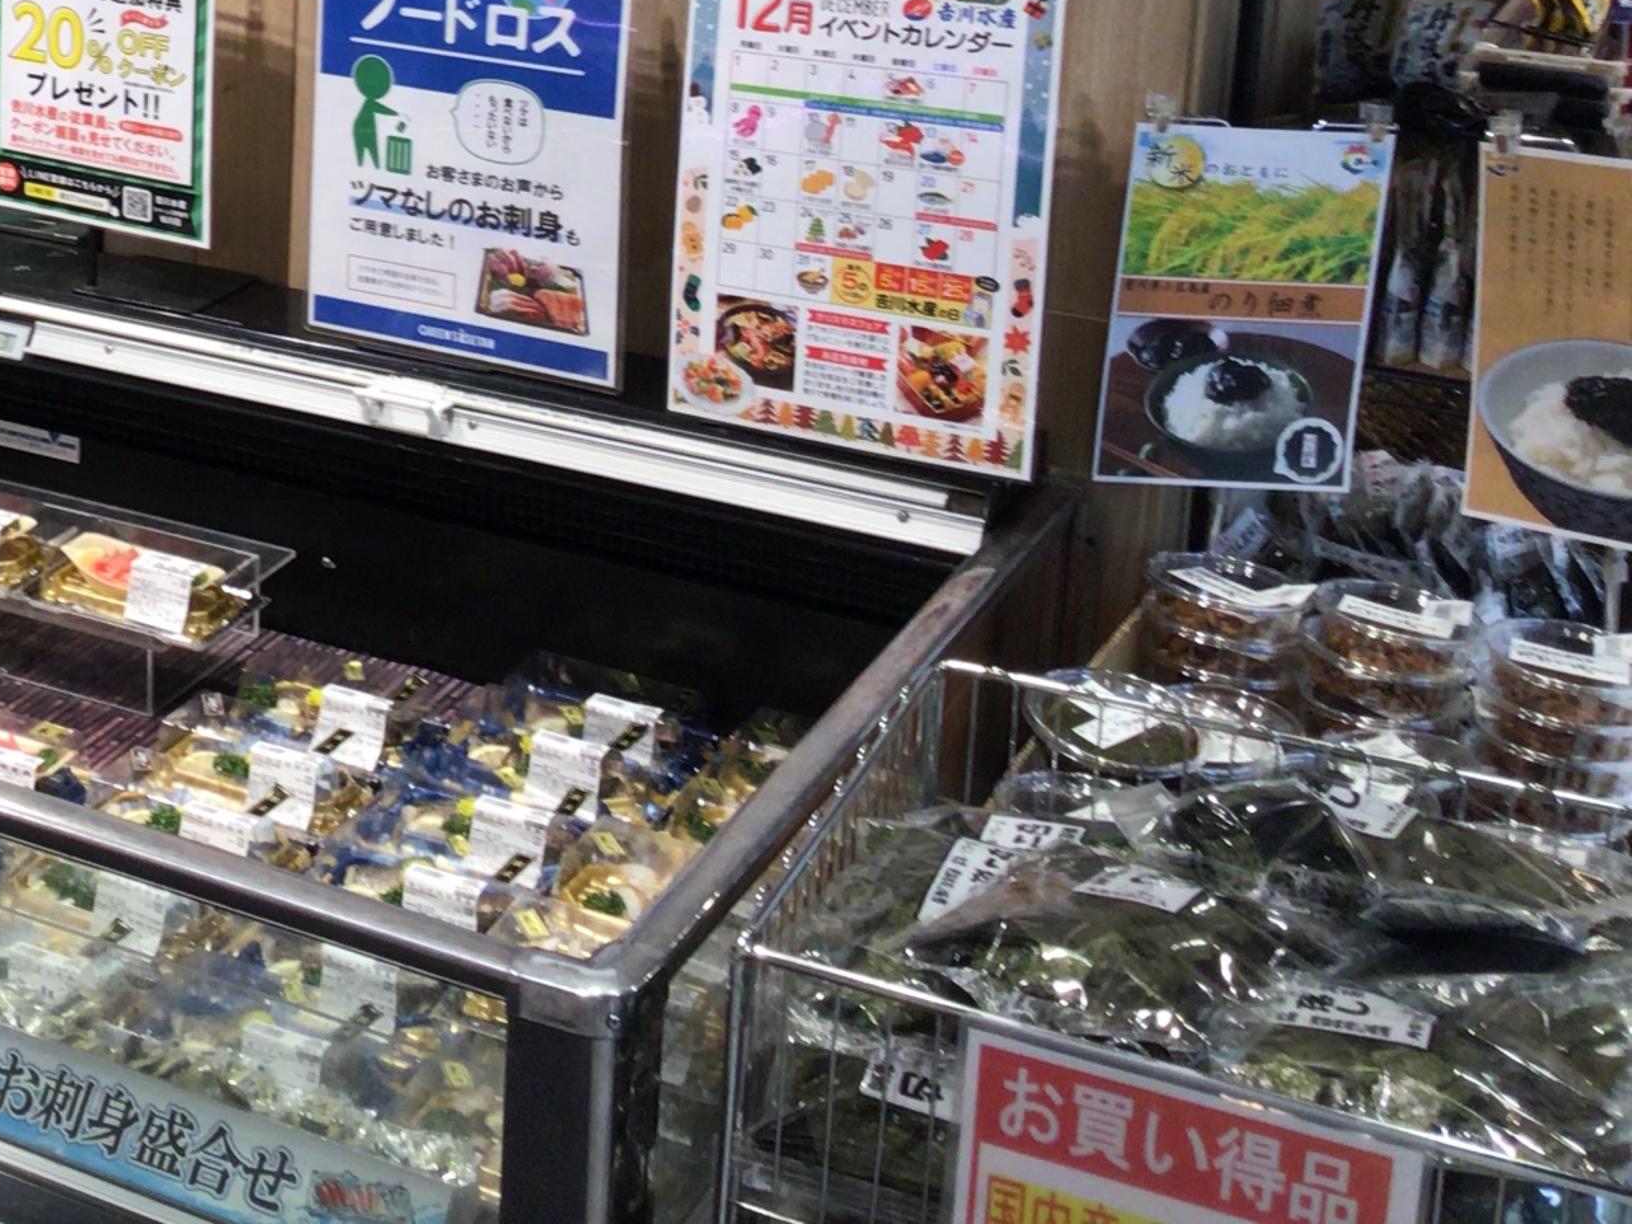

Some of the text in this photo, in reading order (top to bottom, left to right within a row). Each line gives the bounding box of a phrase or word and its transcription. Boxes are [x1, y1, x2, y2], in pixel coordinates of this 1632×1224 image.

[9, 0, 170, 75] 20% OFF
[819, 17, 1013, 53] イベントカレンダー
[118, 59, 187, 87] クーポン
[425, 164, 564, 201] お客さまのお声から
[1145, 143, 1289, 186] 新米 のおともに
[349, 216, 456, 250] ご用意しました!
[350, 180, 581, 247] ツマなしのお刺身も
[1000, 1068, 1360, 1223] お買い得品
